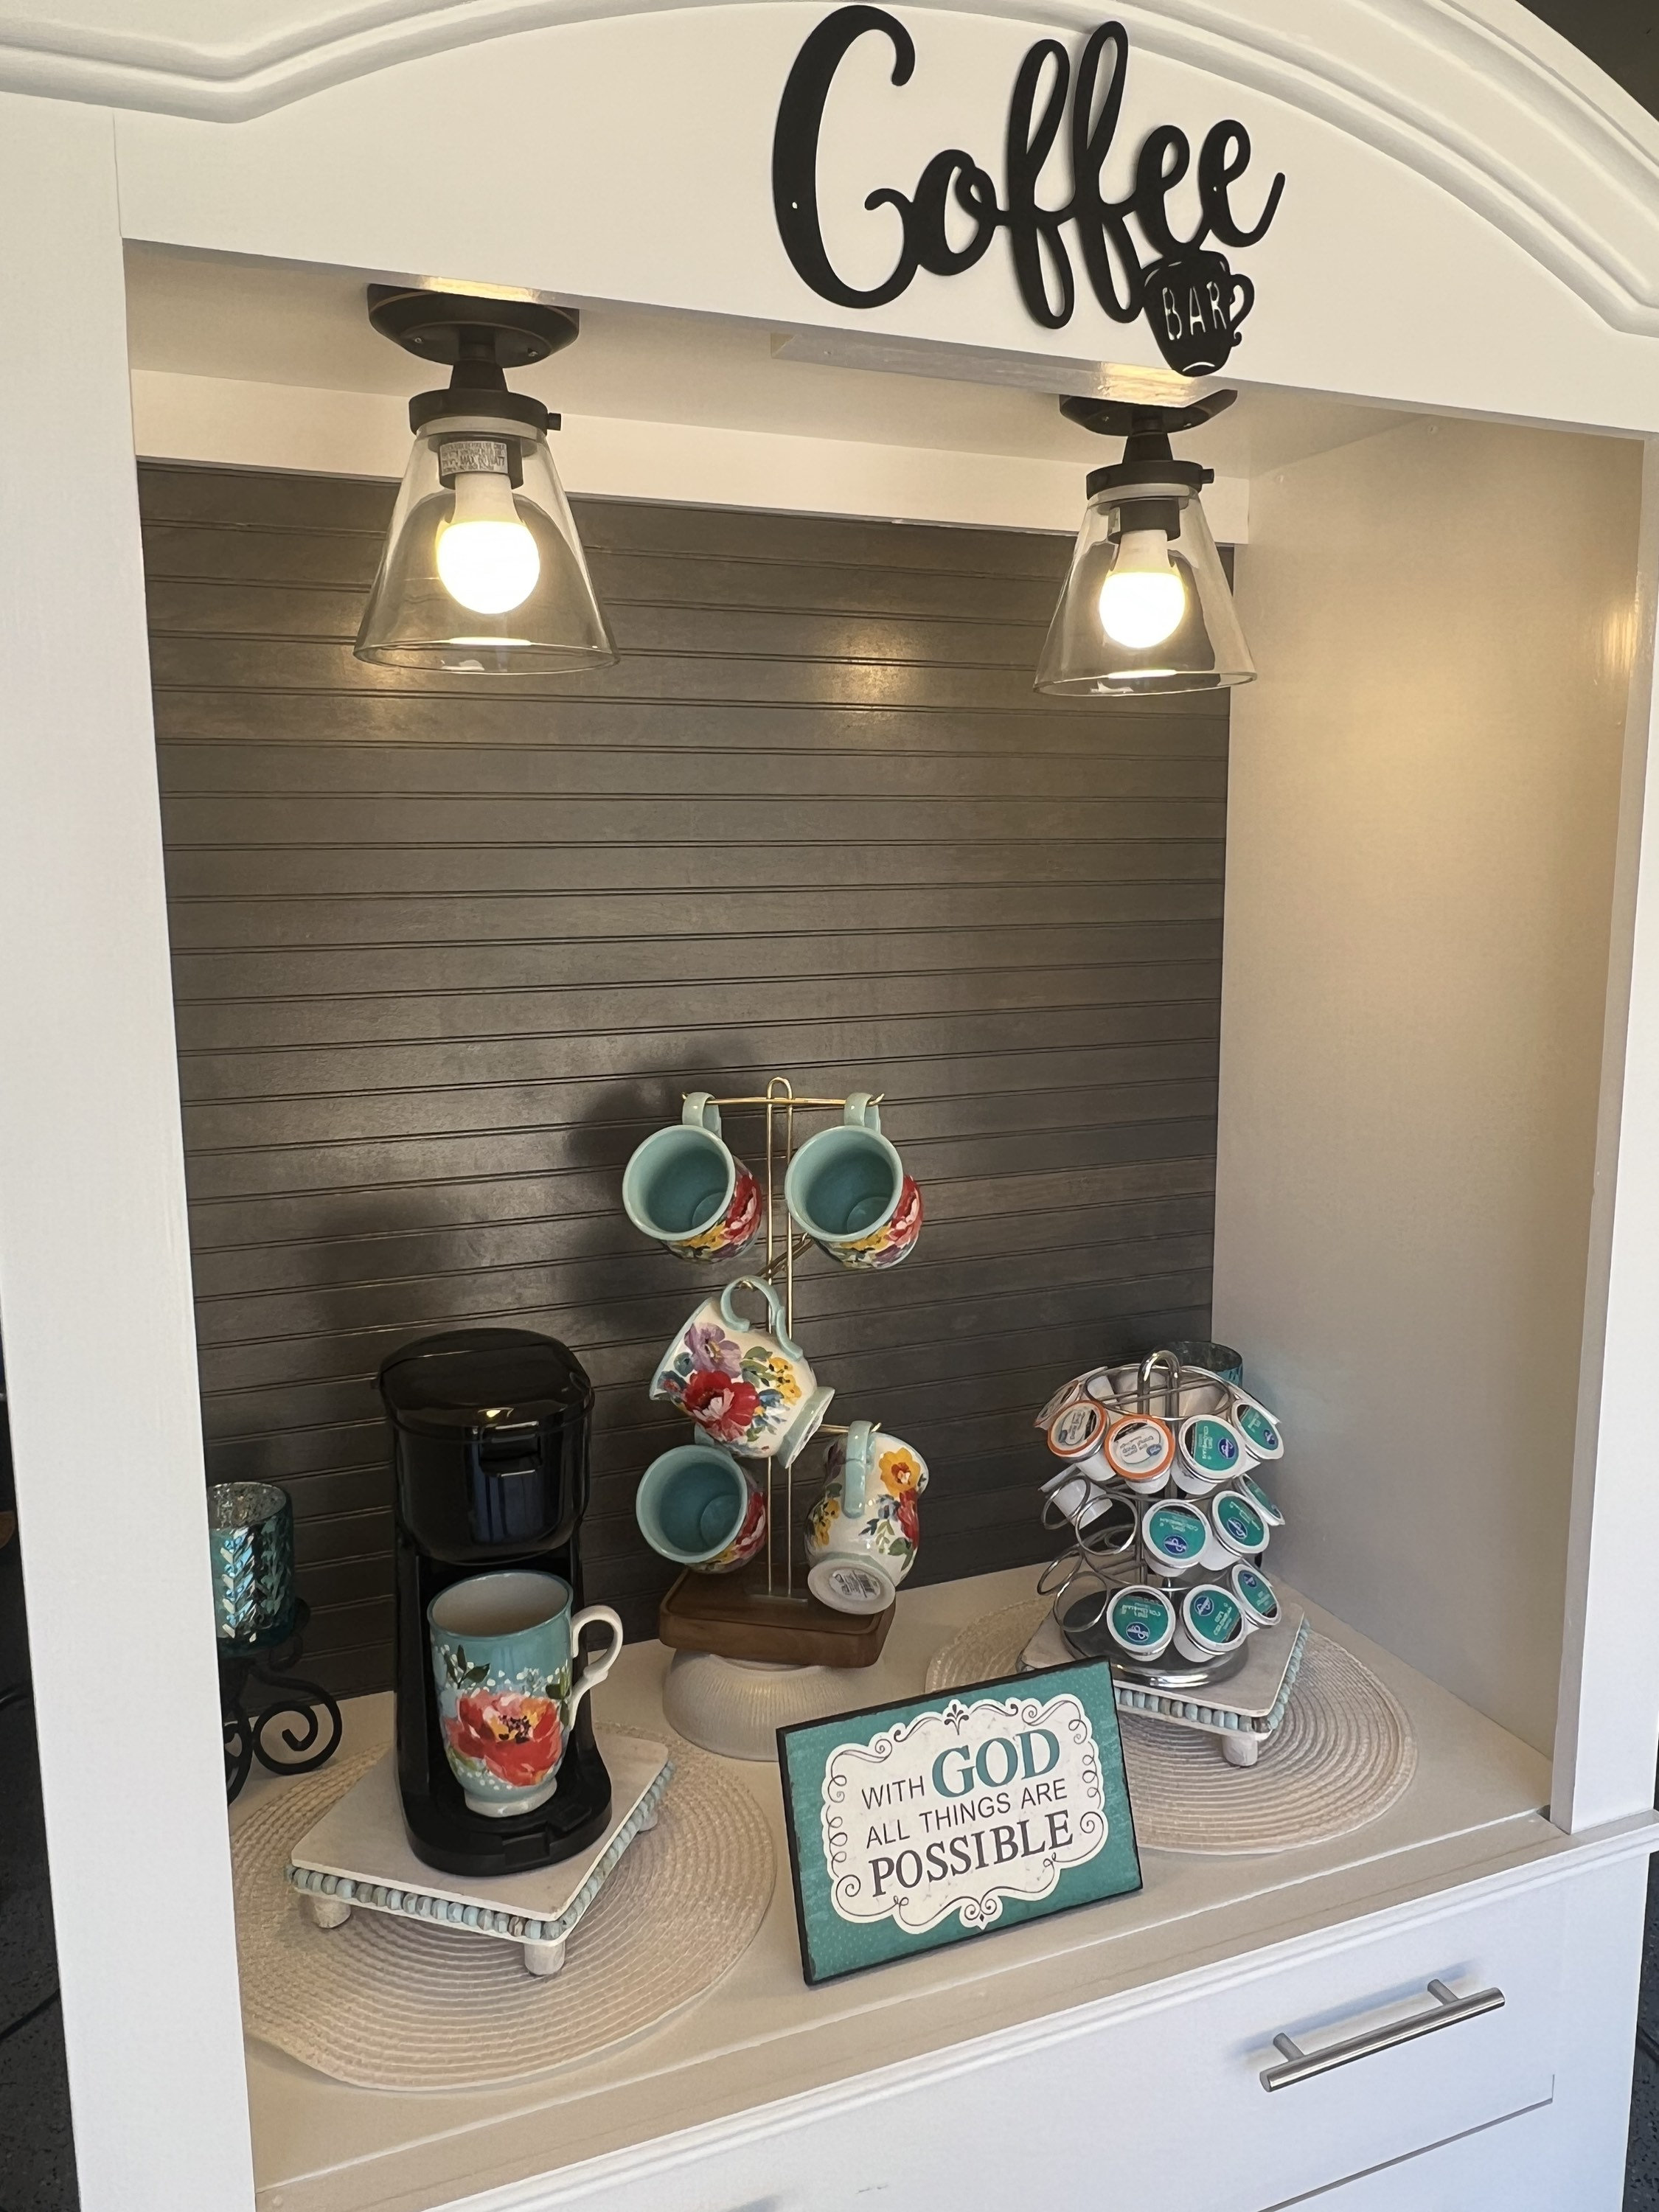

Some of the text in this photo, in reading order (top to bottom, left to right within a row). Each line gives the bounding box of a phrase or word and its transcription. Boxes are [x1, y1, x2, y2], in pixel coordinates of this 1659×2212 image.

[773, 4, 1285, 329] Coffee
[1162, 281, 1227, 341] BAR
[861, 1728, 1060, 1810] WITH GOD
[866, 1778, 1068, 1848] ALL THINGS ARE
[869, 1809, 1074, 1898] POSSIBLE
